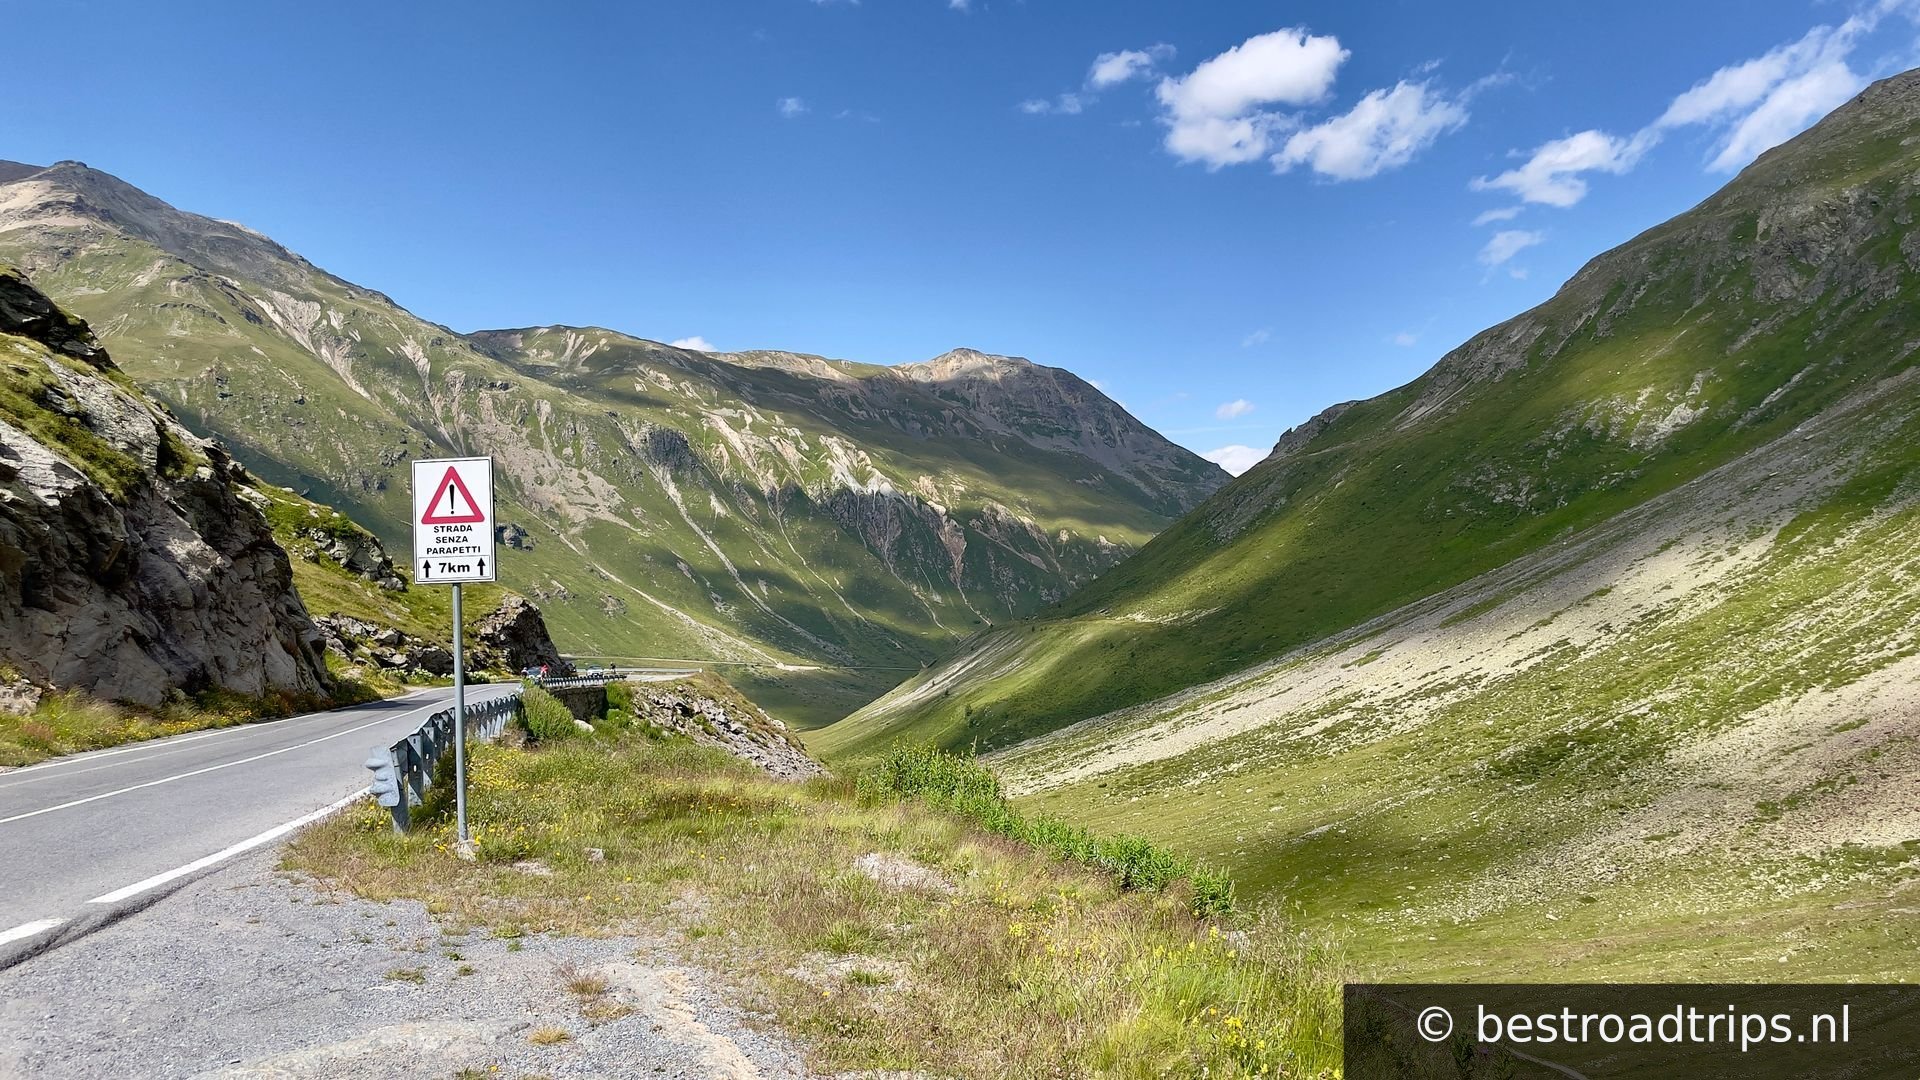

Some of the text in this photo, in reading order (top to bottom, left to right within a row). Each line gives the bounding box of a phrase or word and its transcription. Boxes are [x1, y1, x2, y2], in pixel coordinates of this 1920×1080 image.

[433, 524, 473, 533] STRADA
[435, 536, 469, 544] SENZA
[426, 546, 481, 555] PARAPETTI
[438, 562, 470, 573] 7km
